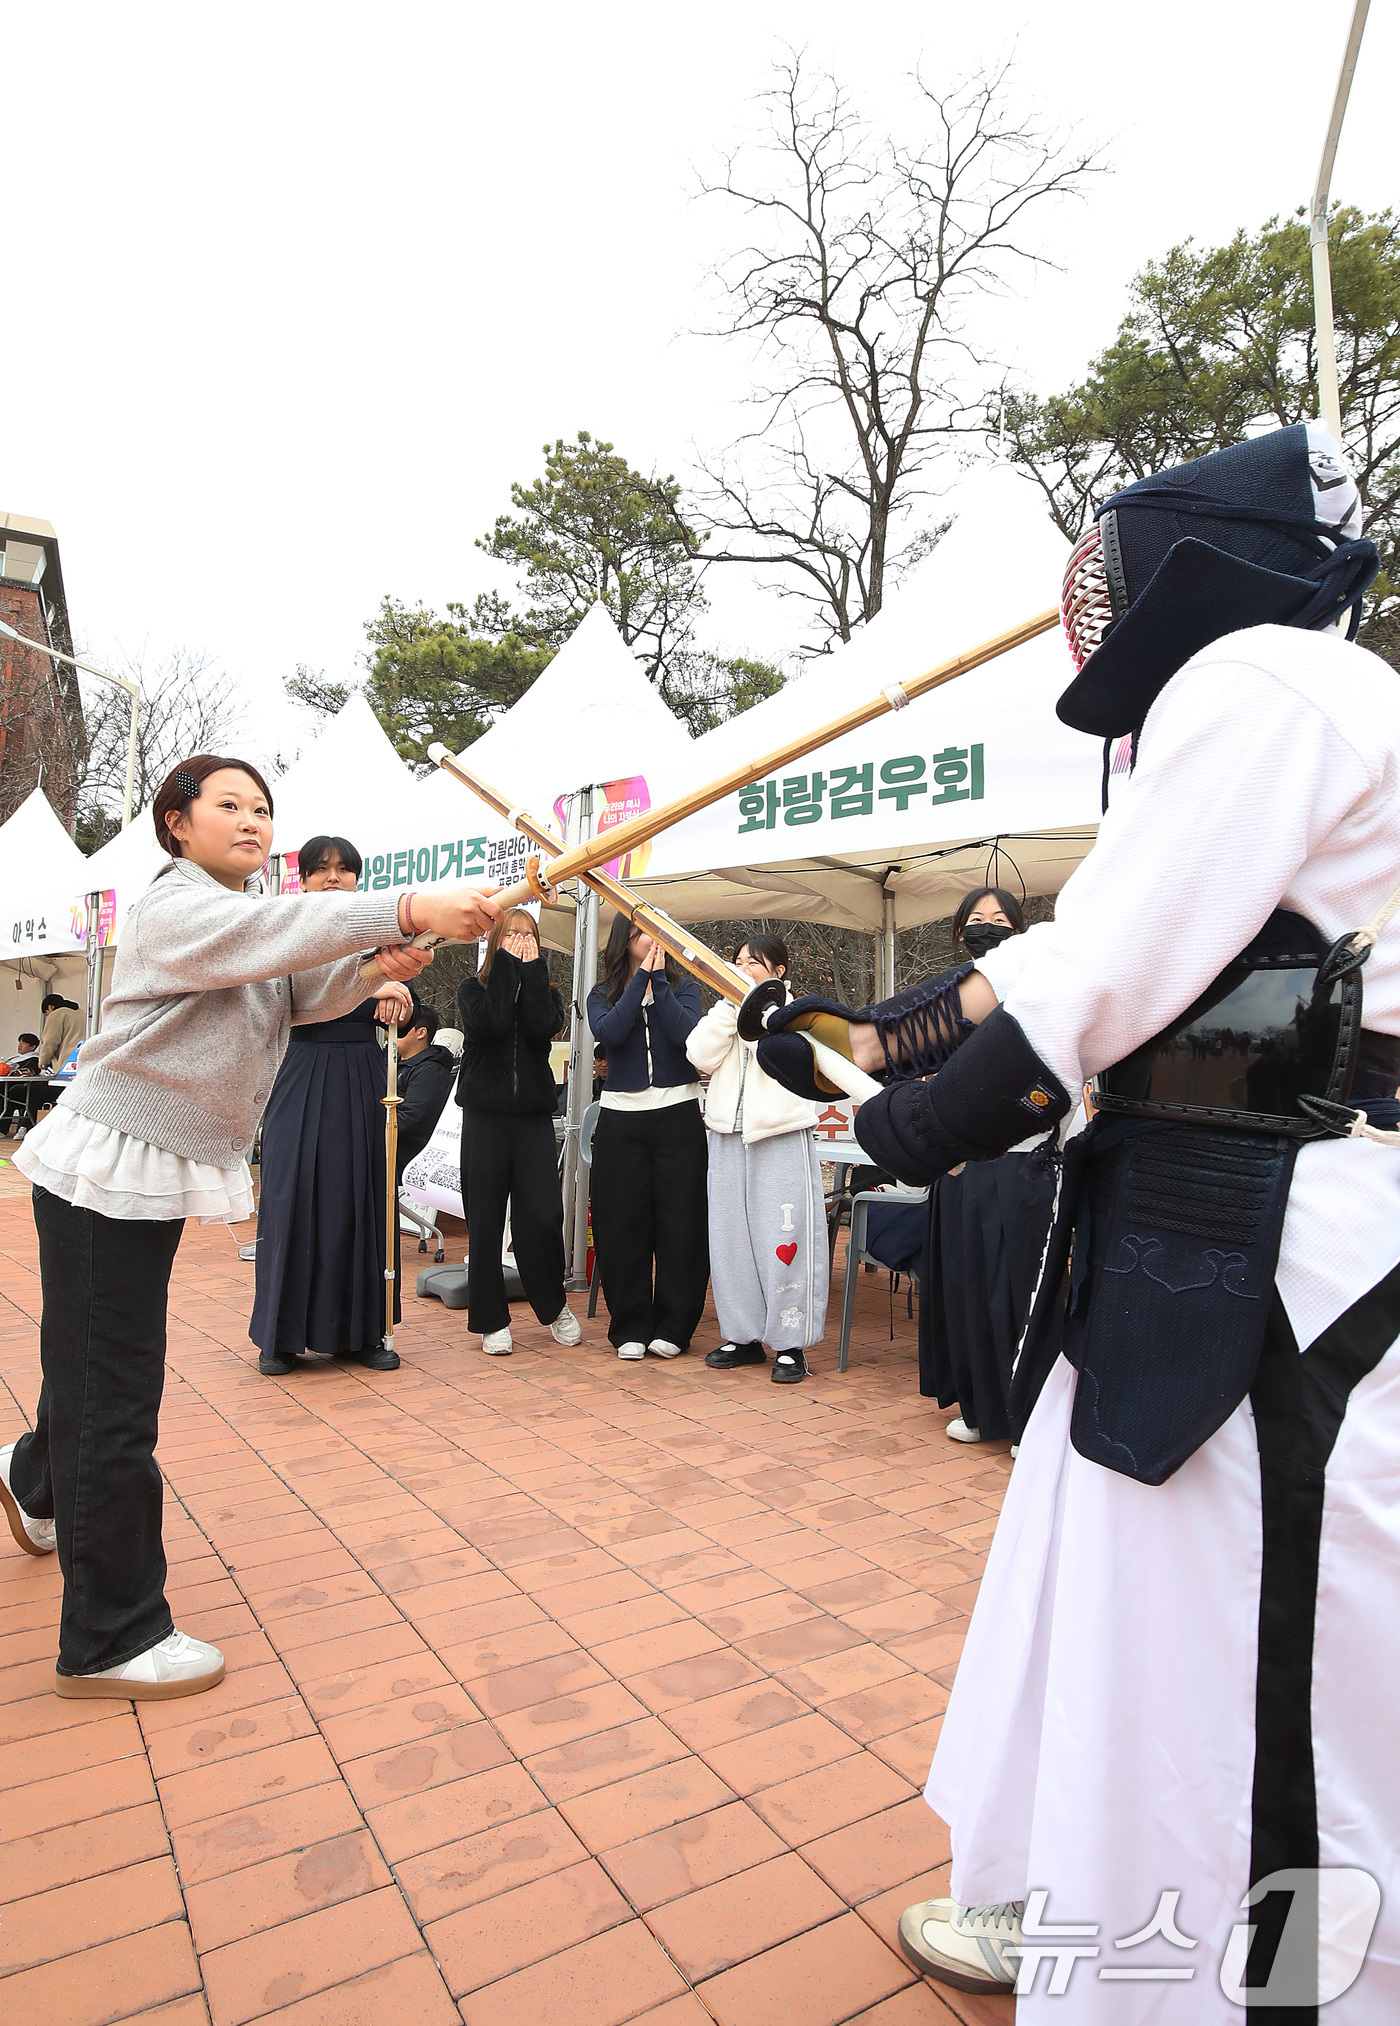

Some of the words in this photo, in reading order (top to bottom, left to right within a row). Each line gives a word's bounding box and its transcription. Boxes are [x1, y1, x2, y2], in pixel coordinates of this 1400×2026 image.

[738, 742, 985, 834] 화랑검우회
[603, 812, 618, 824] 나의
[70, 905, 83, 940] 70
[815, 1105, 861, 1139] 수
[780, 1203, 795, 1232] I
